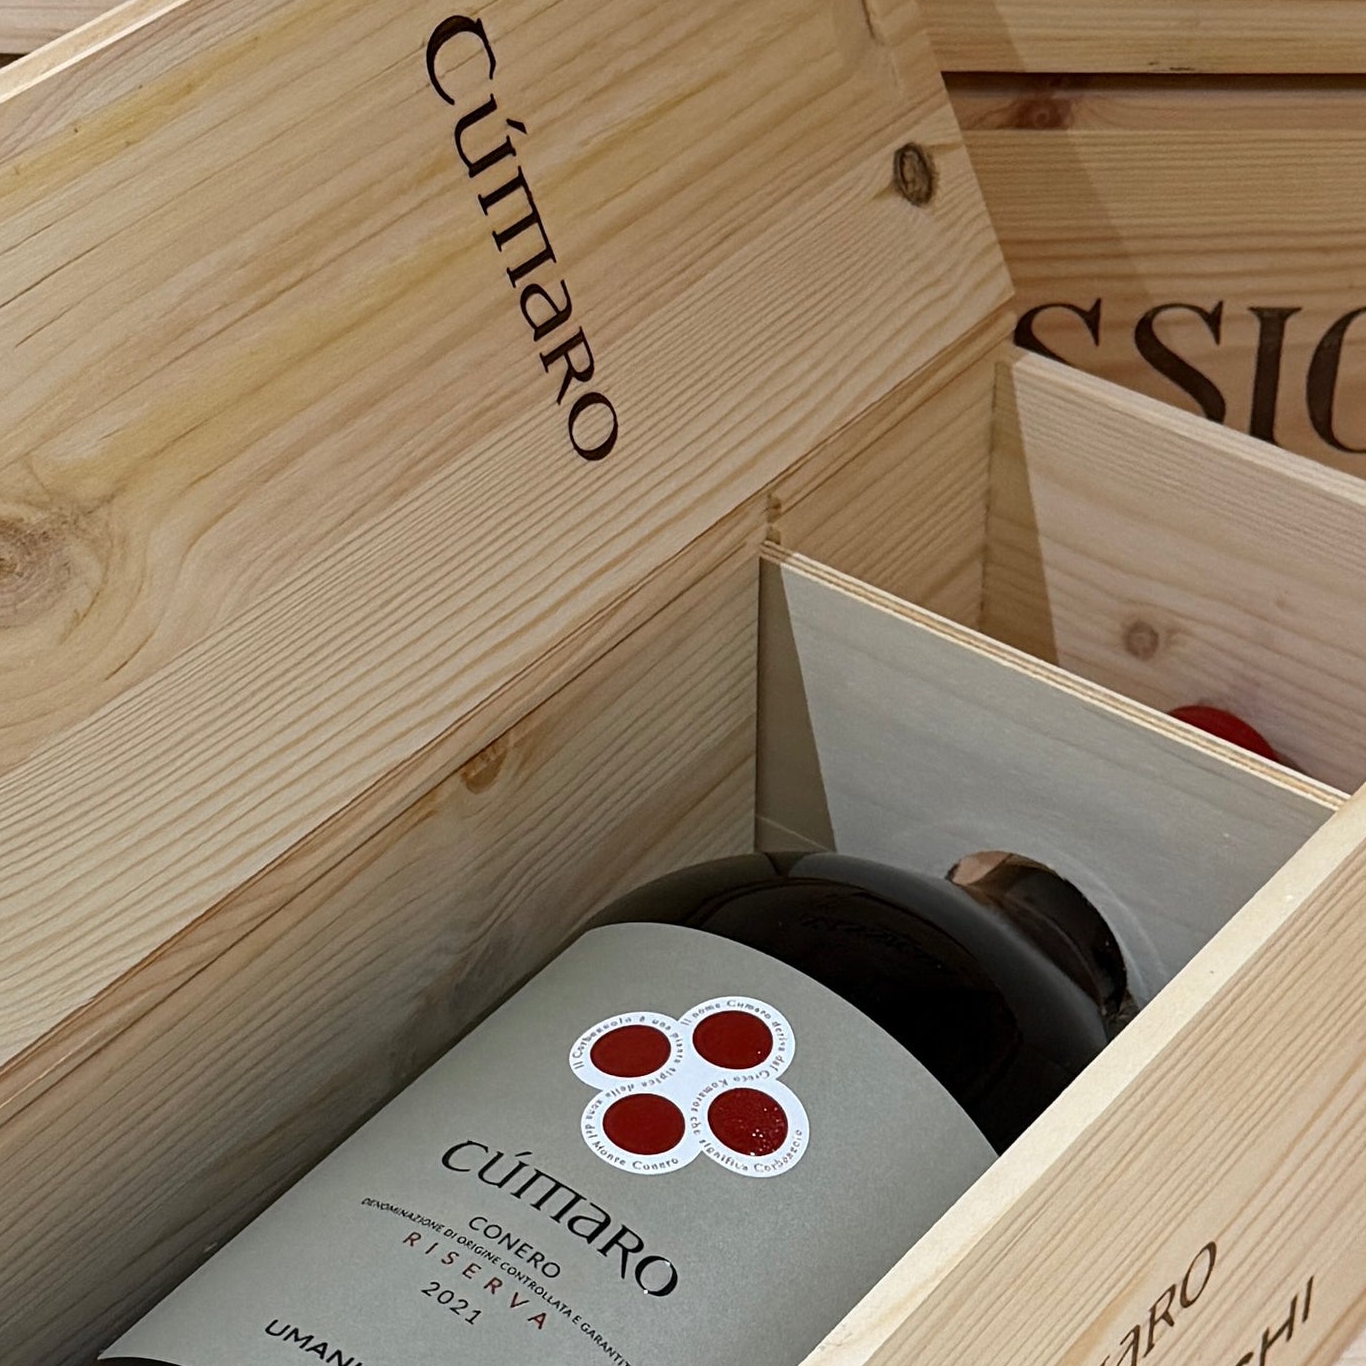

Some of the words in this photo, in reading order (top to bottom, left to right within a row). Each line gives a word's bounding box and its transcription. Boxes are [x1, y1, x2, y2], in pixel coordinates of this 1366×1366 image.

[360, 1196, 445, 1235] DENOMINAZIONE
[443, 1226, 457, 1240] DI
[455, 1234, 502, 1266] ORIGINE
[499, 1260, 573, 1318] CONTROLLATA
[571, 1314, 583, 1326] E
[402, 1231, 548, 1331] RISERVA
[467, 1215, 563, 1280] CONERO
[420, 1280, 484, 1326] 2021
